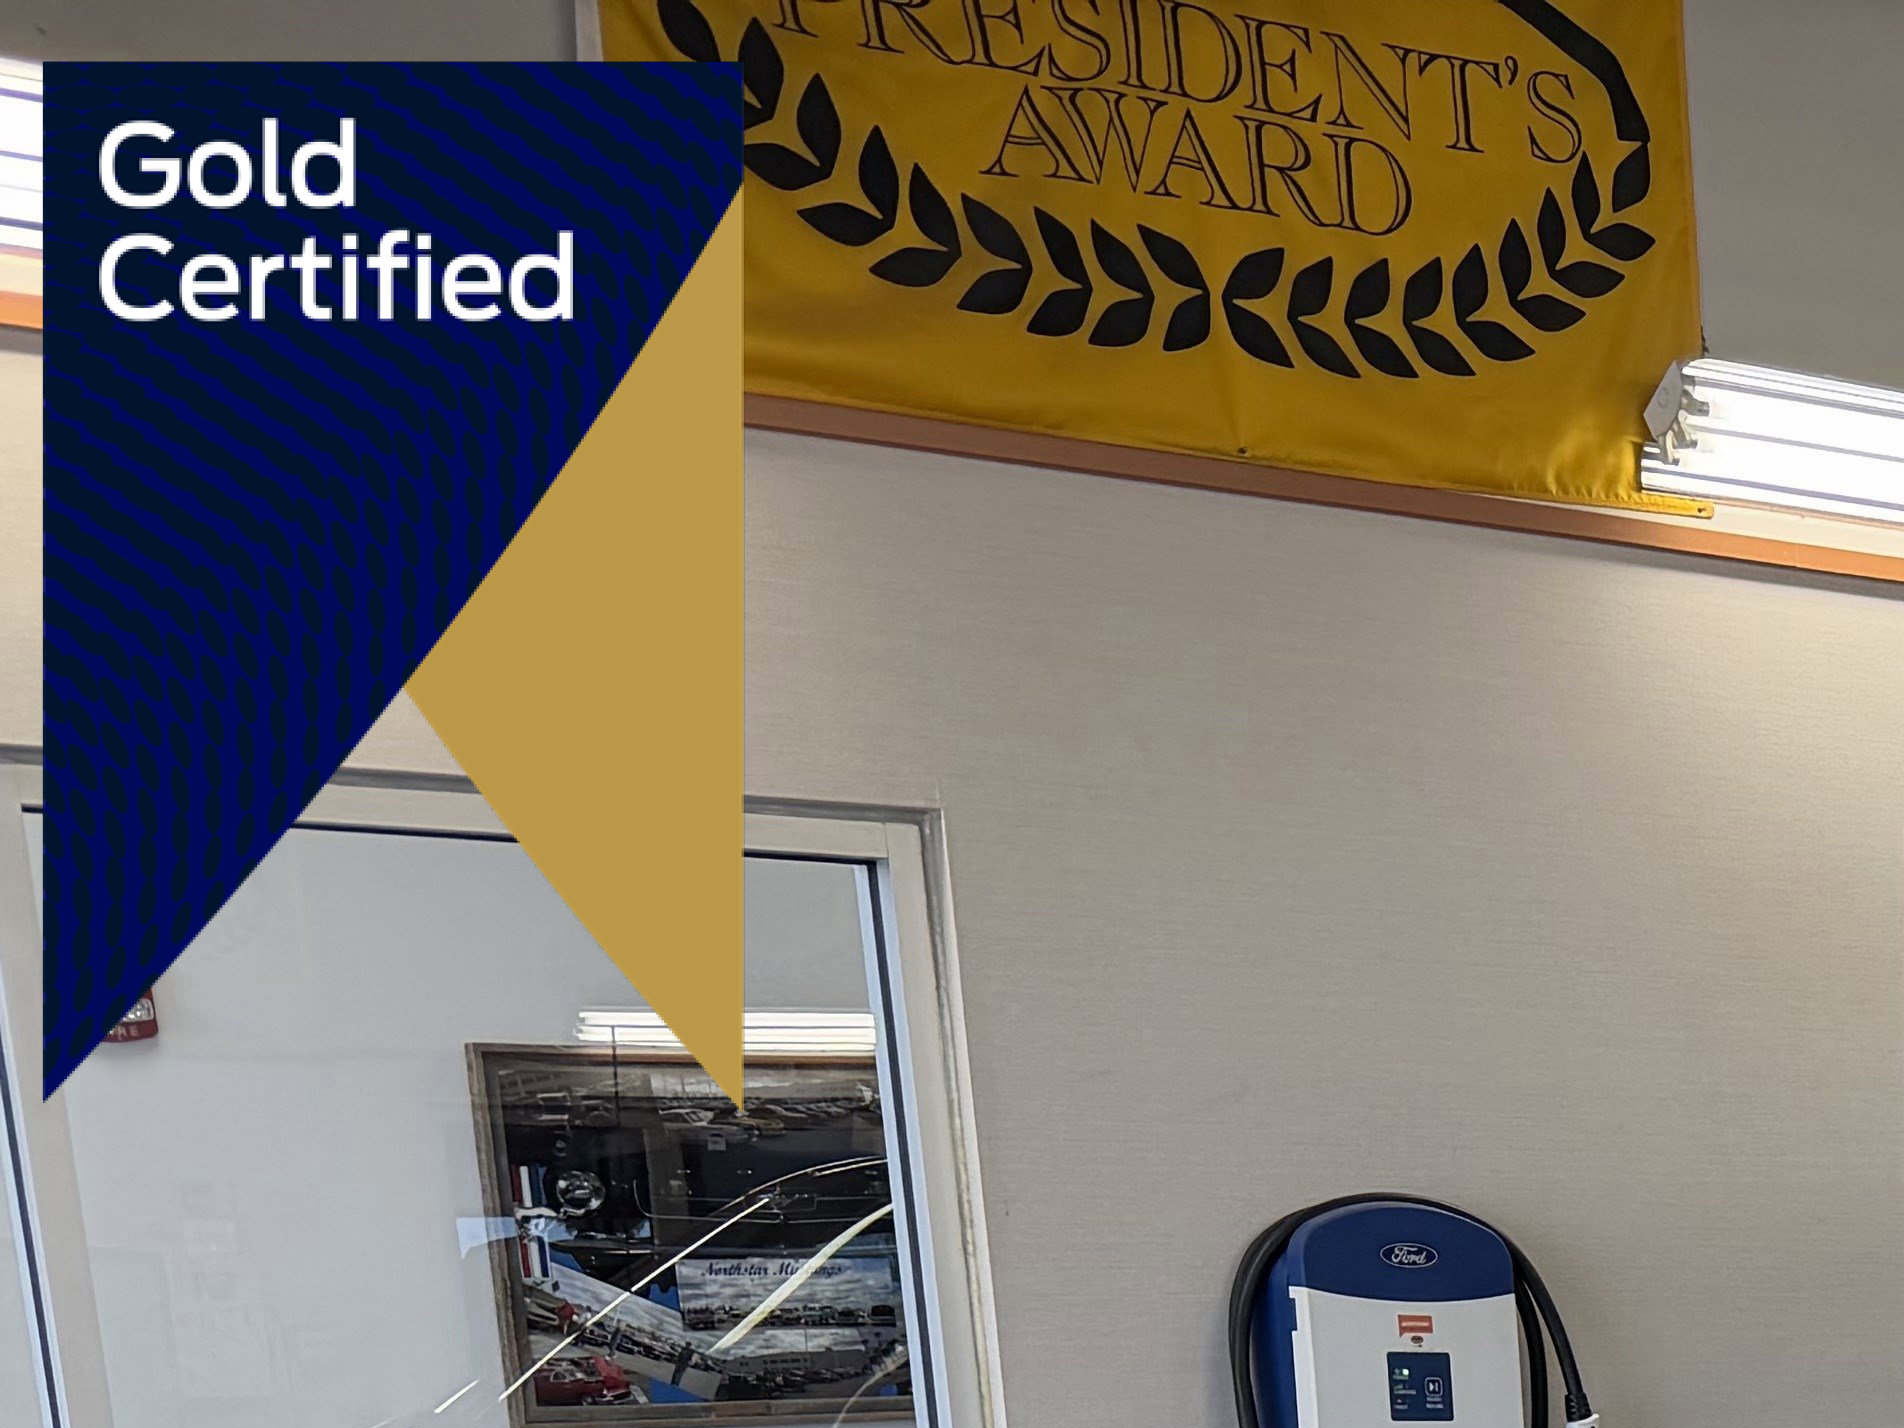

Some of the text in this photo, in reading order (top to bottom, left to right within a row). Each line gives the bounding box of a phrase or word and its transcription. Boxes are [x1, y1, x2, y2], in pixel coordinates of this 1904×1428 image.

[979, 85, 1411, 237] AWARD
[1391, 1246, 1427, 1264] Ford
[701, 1261, 769, 1278] Northstar
